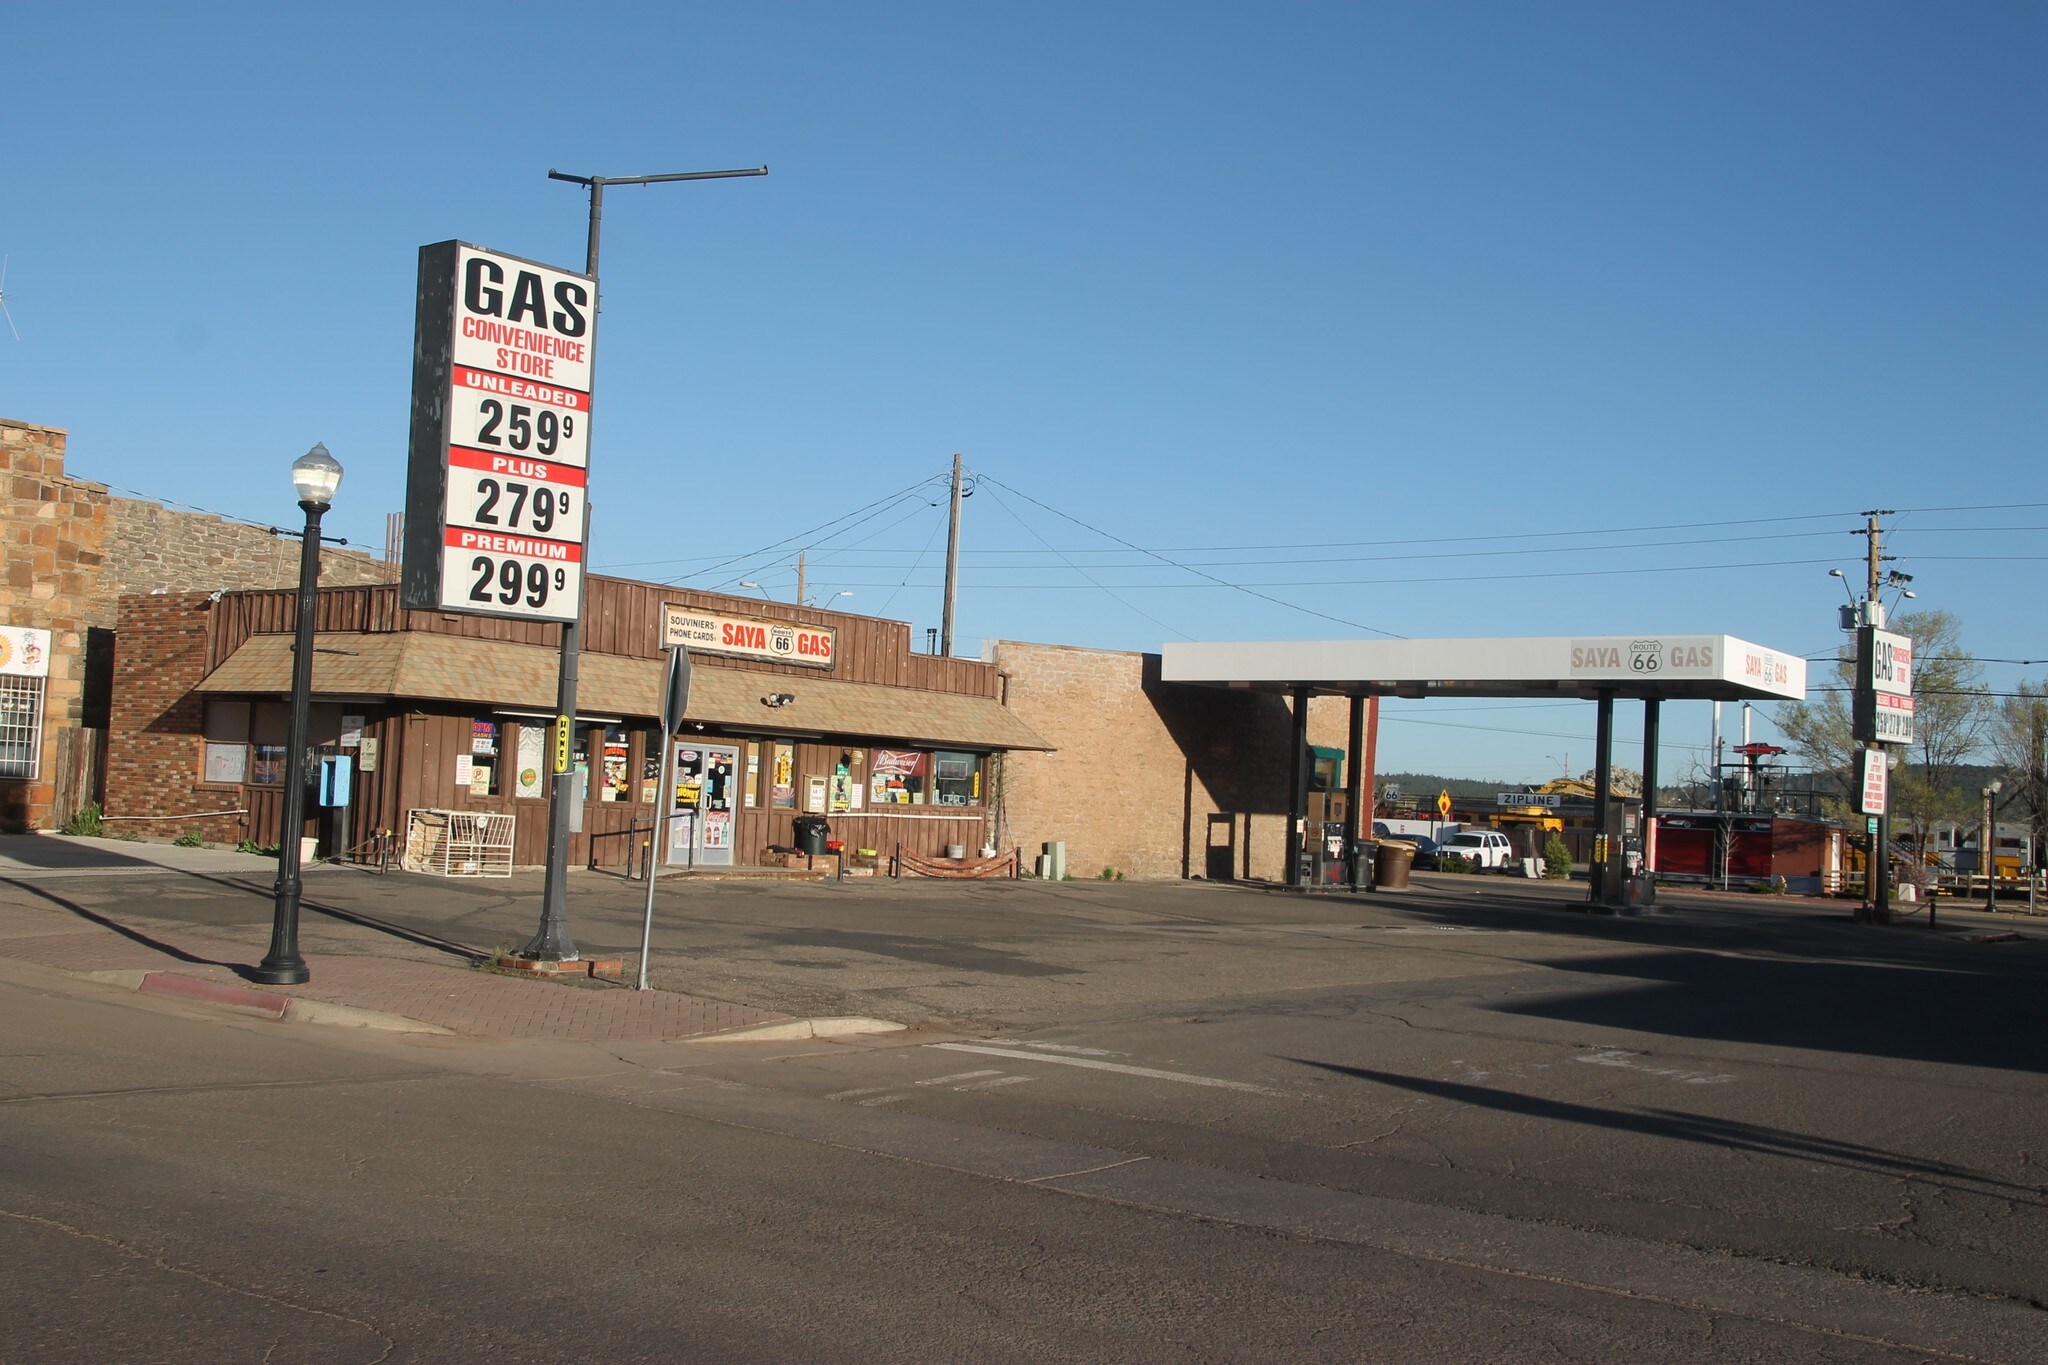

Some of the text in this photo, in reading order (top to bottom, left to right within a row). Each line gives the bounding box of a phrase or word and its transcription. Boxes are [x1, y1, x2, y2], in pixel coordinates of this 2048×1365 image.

[464, 257, 586, 338] GAS
[463, 317, 585, 363] CONVENIENCE
[496, 348, 554, 379] STORE
[466, 372, 577, 407] UNLEADED
[493, 457, 547, 479] PLUS
[461, 532, 566, 559] PREMIUM
[669, 628, 691, 639] PHONE
[722, 623, 830, 657] SAYA 66 GAS
[1571, 646, 1713, 670] SAYA 66 GAS
[1633, 643, 1658, 651] ROUTE
[1746, 654, 1761, 678] SAYA
[1775, 663, 1787, 685] GAS
[1875, 640, 1892, 682] GAS
[473, 723, 492, 733] ATM
[878, 753, 916, 767] Budweiser
[677, 788, 699, 799] HONEY
[1386, 791, 1398, 800] 66
[1504, 794, 1554, 806] ZIPLINE
